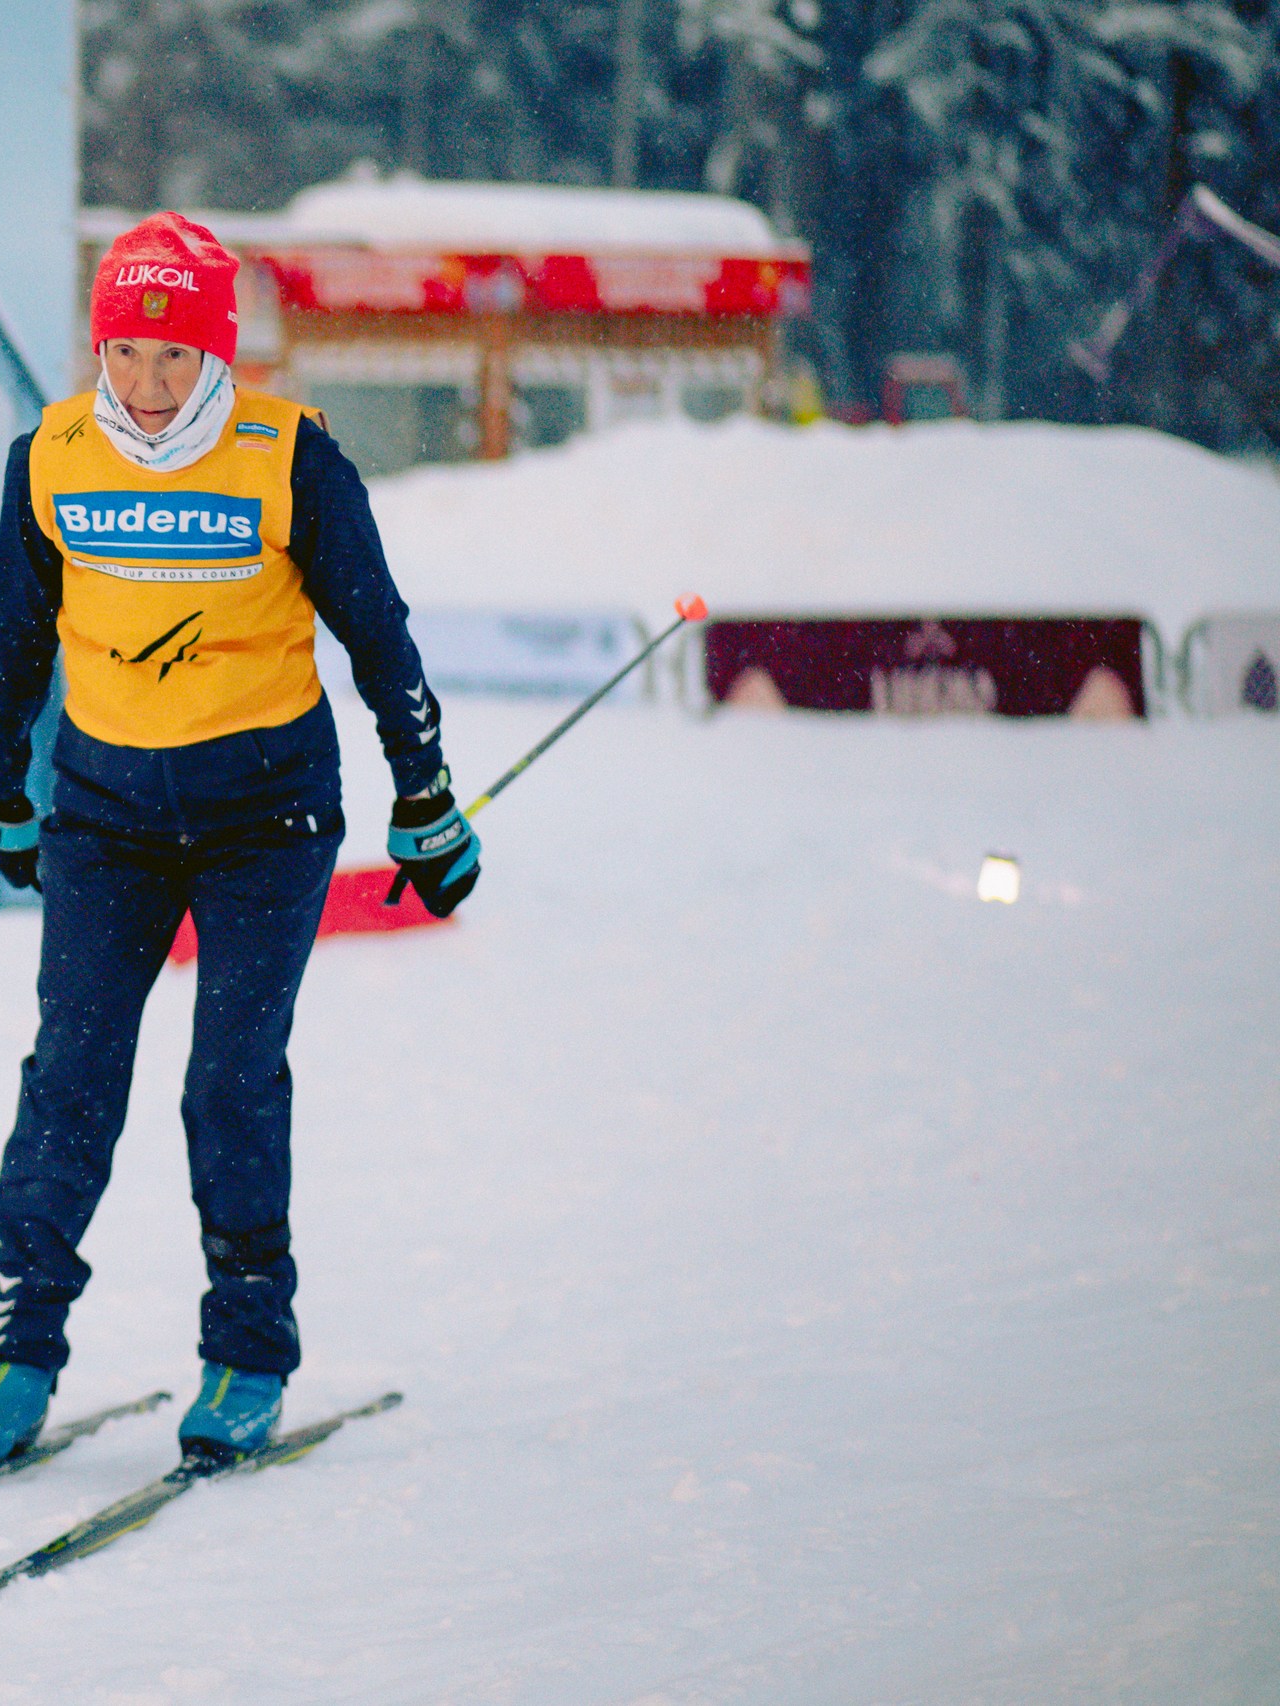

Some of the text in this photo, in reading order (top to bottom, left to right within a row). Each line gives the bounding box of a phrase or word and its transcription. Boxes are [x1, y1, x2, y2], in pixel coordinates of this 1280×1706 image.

[115, 264, 200, 292] LUKOIL
[58, 502, 253, 539] Buderus
[123, 569, 144, 578] CUP
[152, 570, 193, 579] CROSS
[201, 566, 260, 579] COUNTRY
